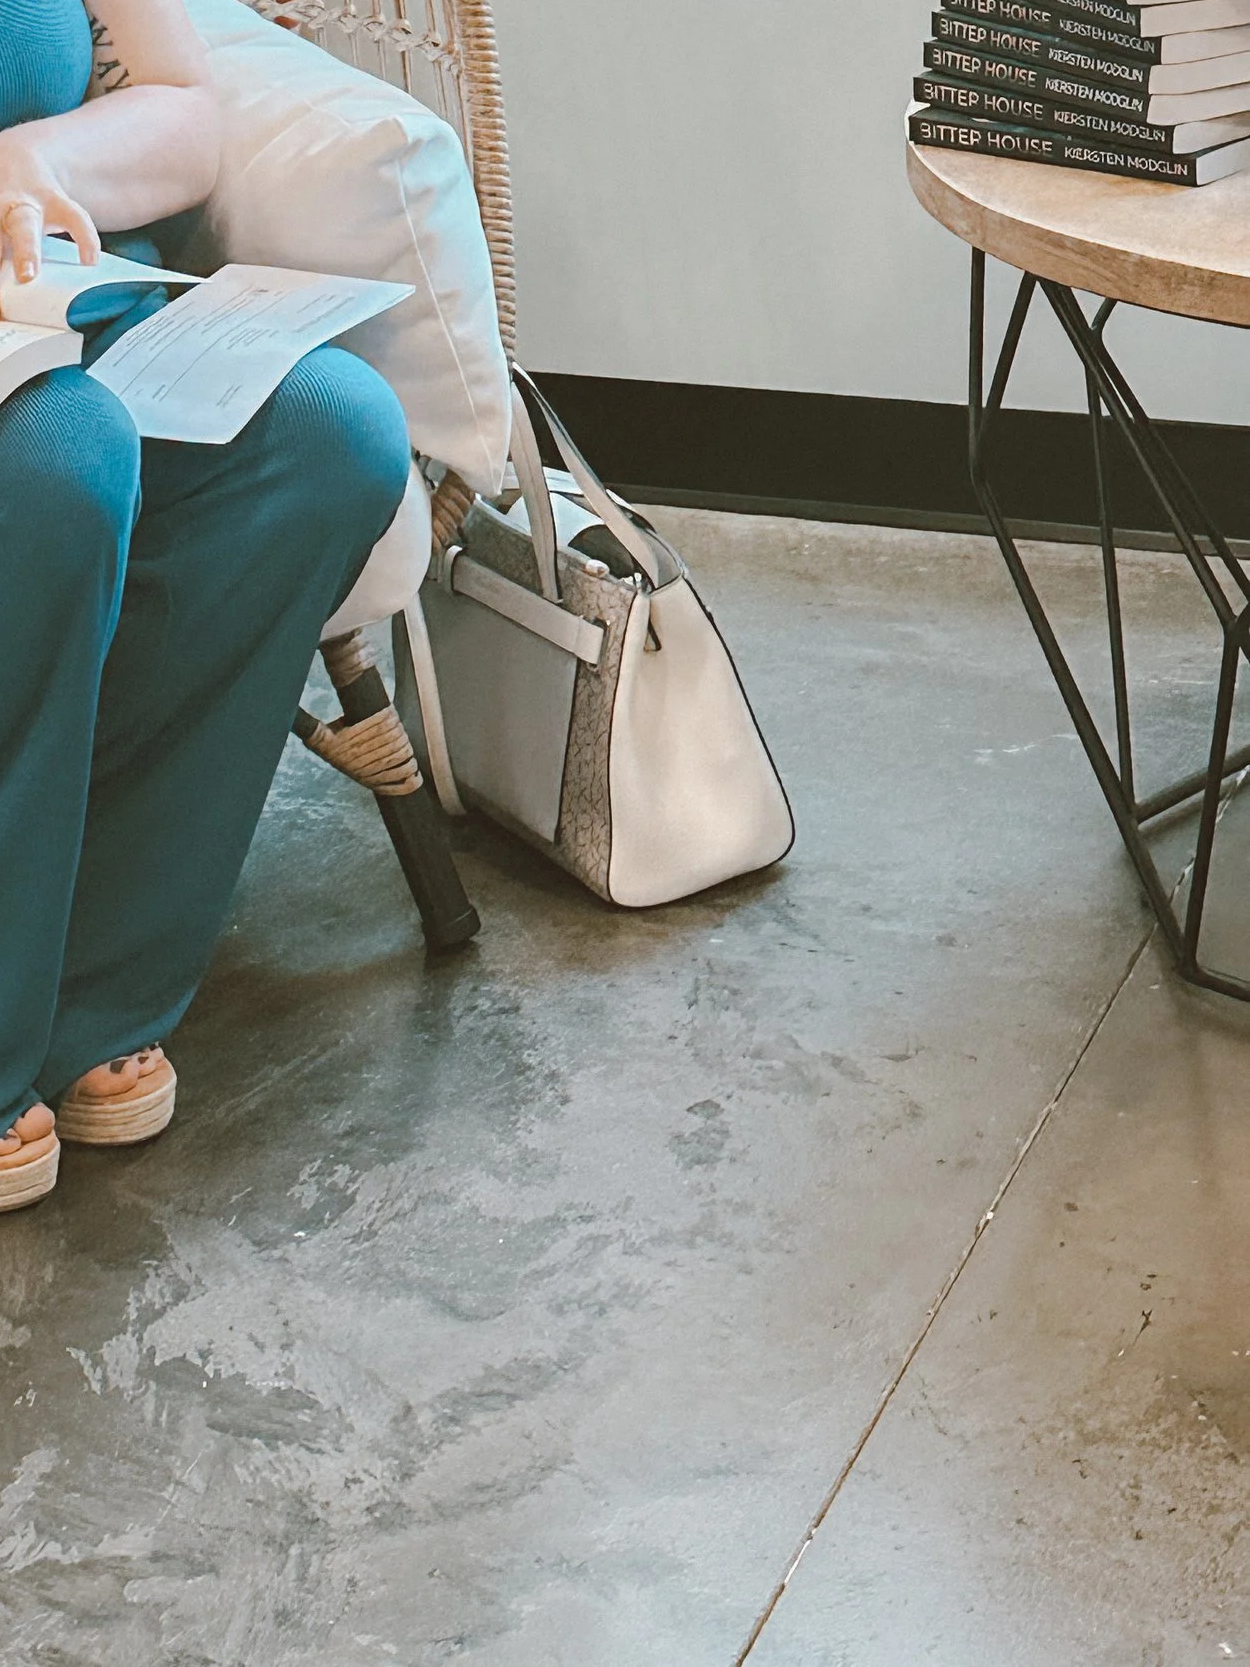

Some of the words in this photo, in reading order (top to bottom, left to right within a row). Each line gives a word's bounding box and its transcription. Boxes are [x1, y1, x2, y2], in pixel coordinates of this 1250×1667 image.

[999, 1, 1051, 24] HOUSE
[940, 18, 987, 43] BITTER
[990, 30, 1042, 58] HOUSE
[932, 48, 981, 74] BITTER
[985, 59, 1037, 88] HOUSE
[923, 83, 980, 107] BITTER
[984, 95, 1044, 121] HOUSE
[1054, 109, 1108, 132] KIERSTEN
[920, 122, 981, 145] BITTER
[987, 131, 1053, 156] HOUSE
[1064, 146, 1125, 167] KIERSTEN
[1127, 156, 1188, 176] MODGLIN
